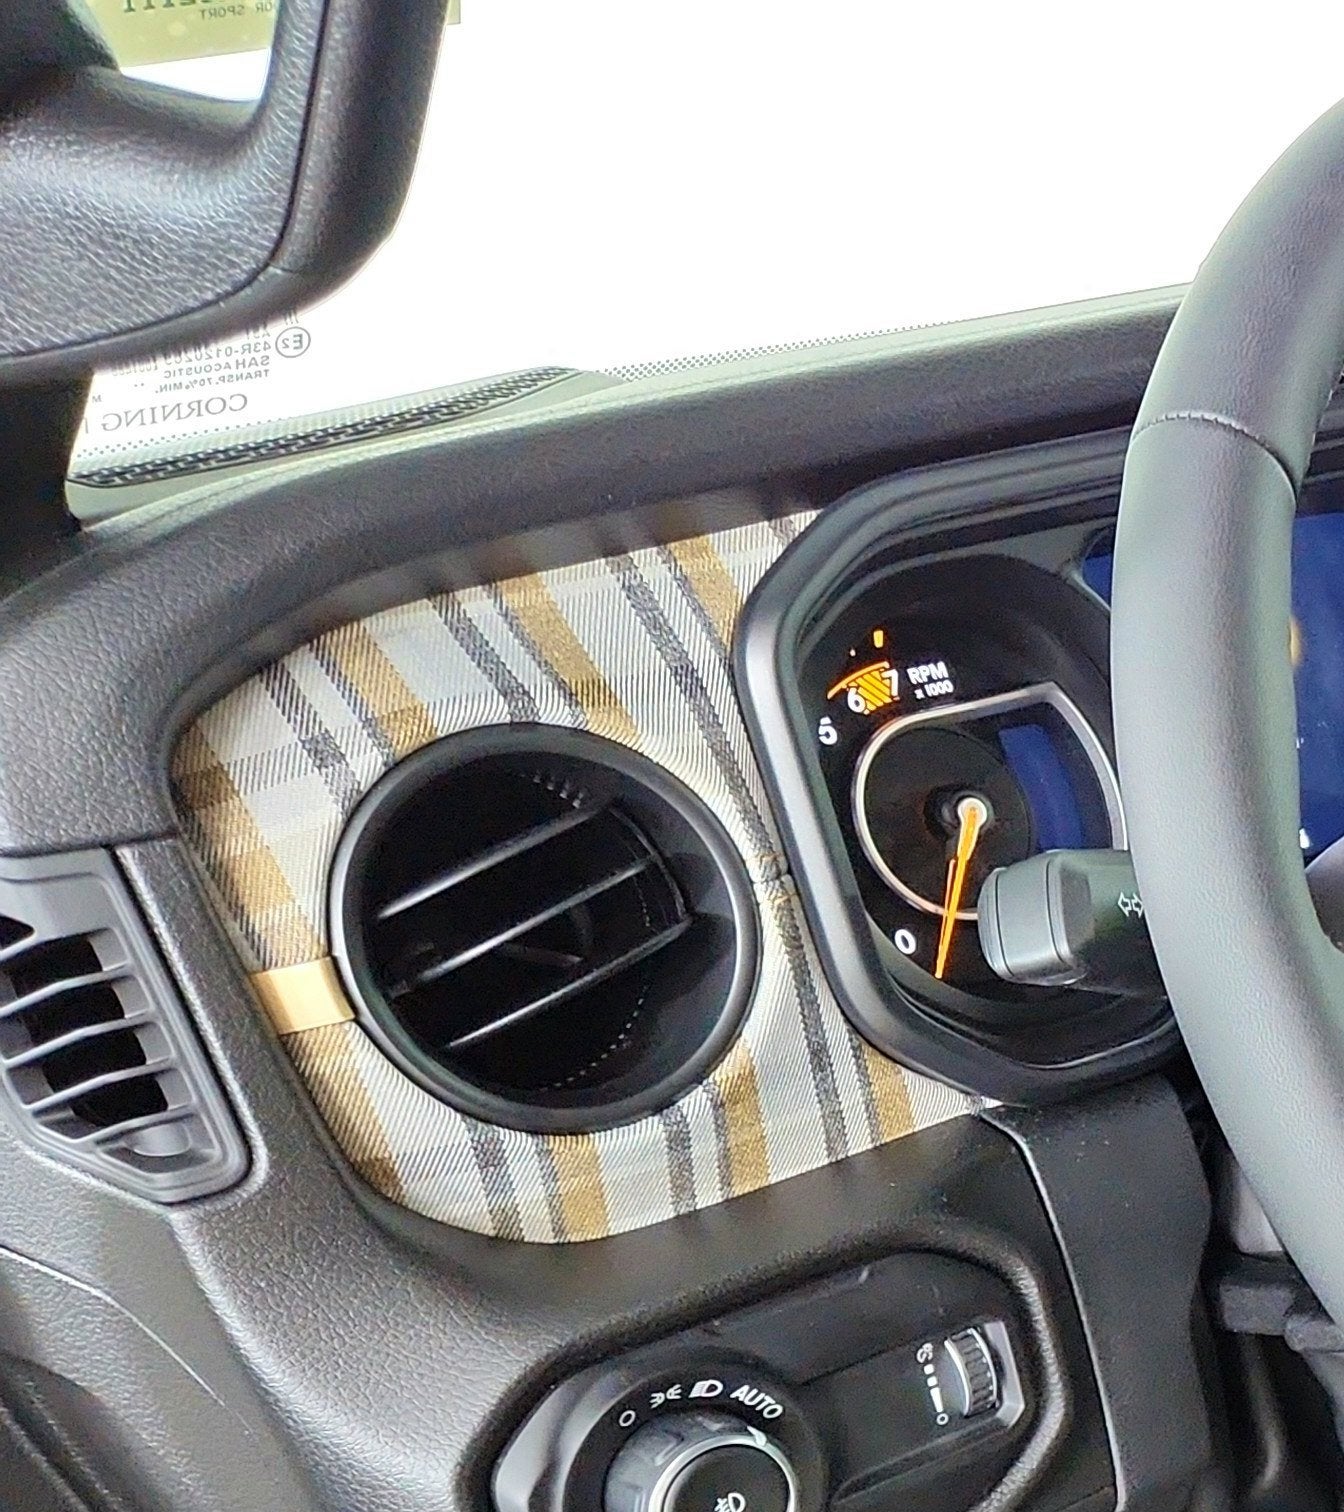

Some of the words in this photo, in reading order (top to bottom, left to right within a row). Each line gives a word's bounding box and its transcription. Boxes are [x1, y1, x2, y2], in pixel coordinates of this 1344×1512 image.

[881, 668, 899, 697] 7
[906, 660, 949, 685] RPM
[924, 679, 954, 697] 1000
[847, 687, 866, 713] 6
[818, 716, 838, 746] 5
[894, 929, 918, 955] 0
[730, 1383, 783, 1420] AUTO
